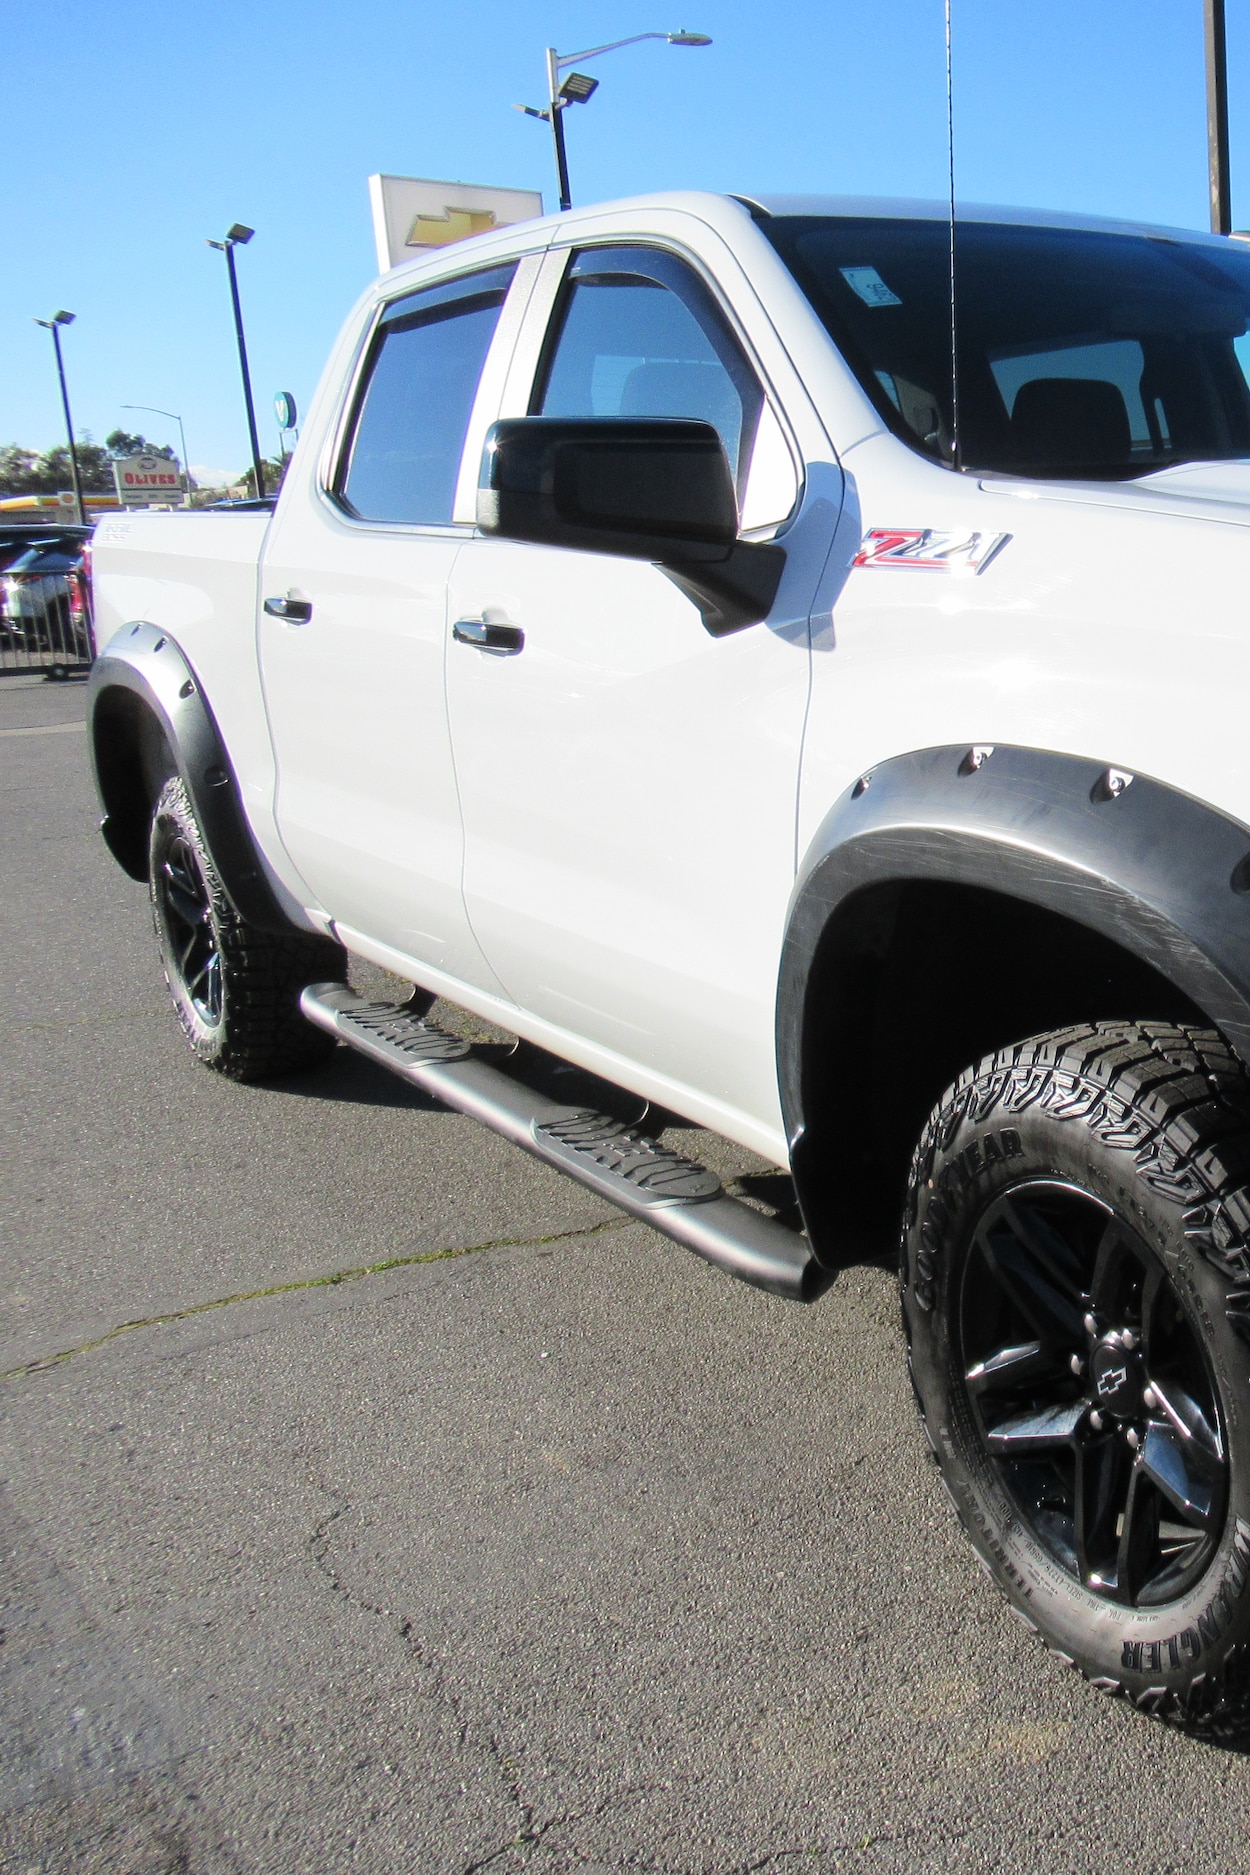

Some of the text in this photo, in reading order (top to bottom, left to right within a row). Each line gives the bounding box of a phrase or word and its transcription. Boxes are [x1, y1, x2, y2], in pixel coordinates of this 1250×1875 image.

[123, 472, 177, 485] OLIVES
[846, 527, 1014, 577] Z71
[913, 1126, 1026, 1312] GOODYEAR
